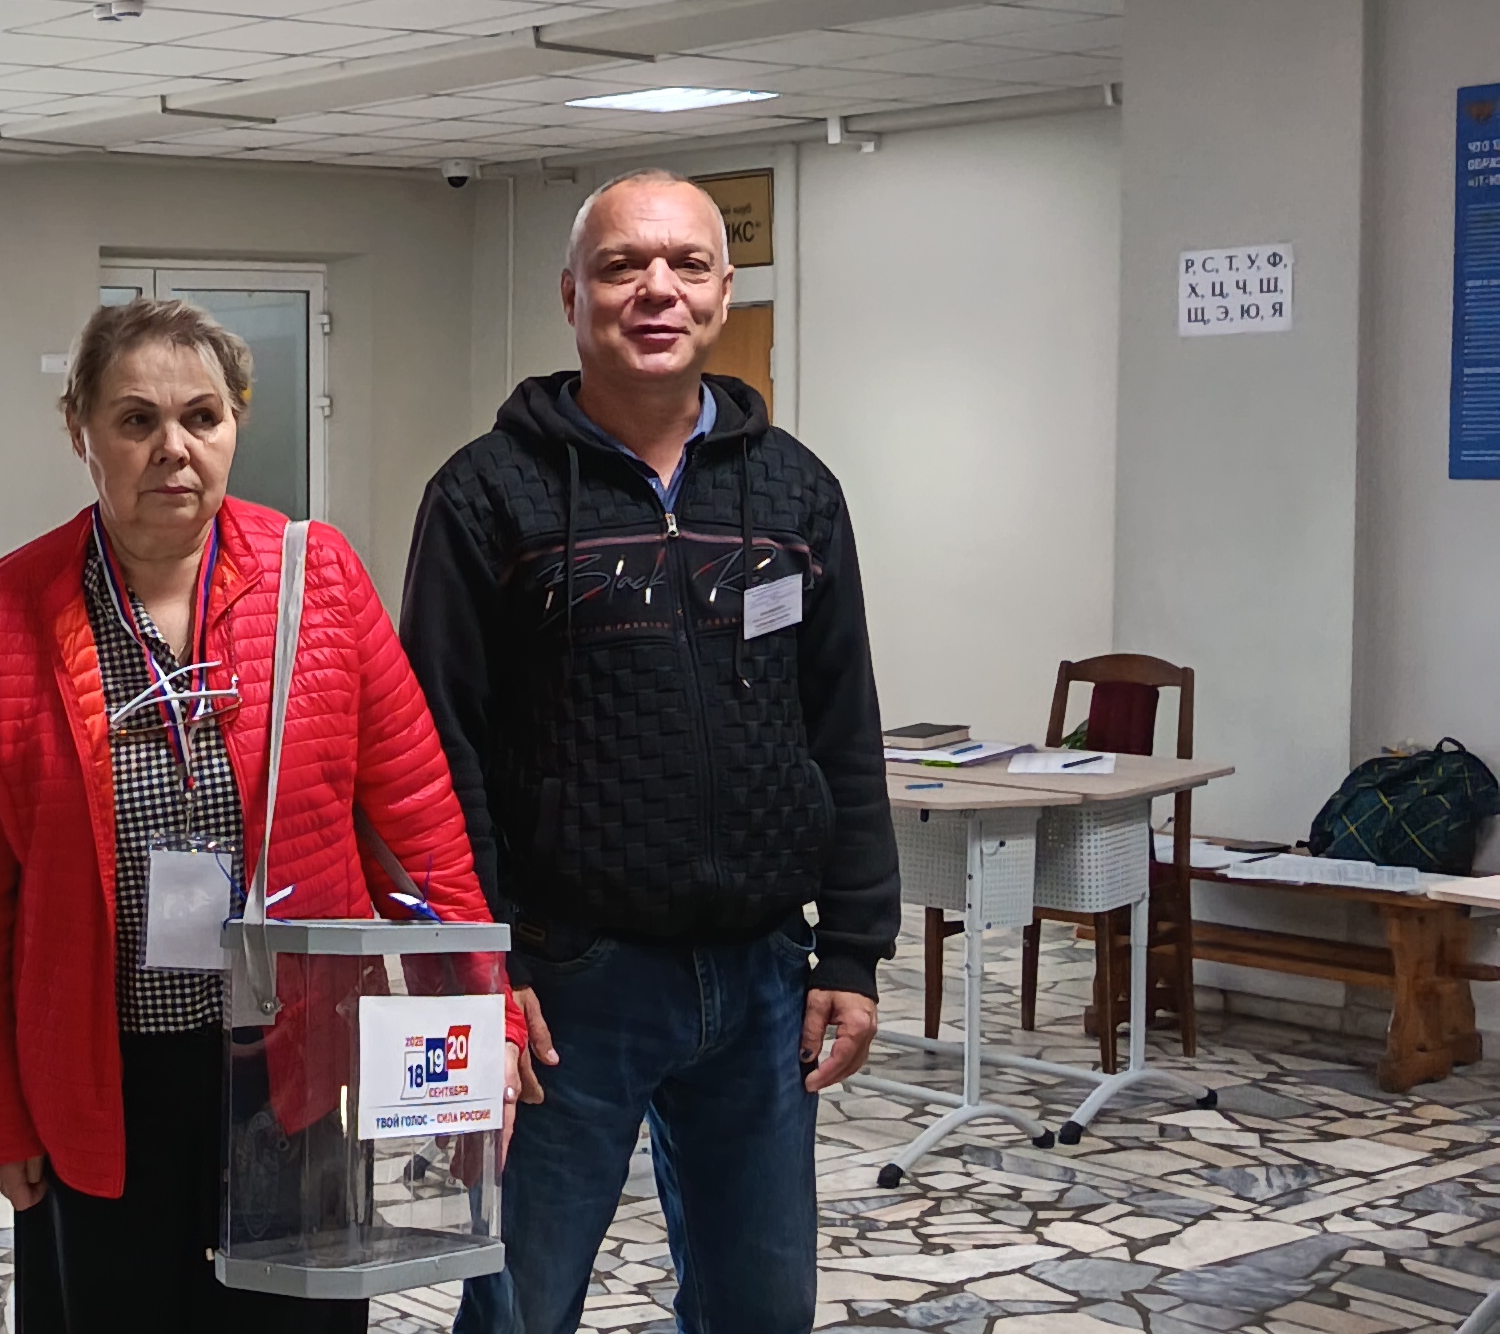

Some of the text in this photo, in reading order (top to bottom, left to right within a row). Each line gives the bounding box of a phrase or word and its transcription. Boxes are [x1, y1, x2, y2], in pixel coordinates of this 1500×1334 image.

[1267, 251, 1287, 269] Ф,
[1240, 303, 1264, 321] Ю,
[1270, 301, 1283, 318] Я
[447, 1034, 467, 1060] 20
[427, 1048, 444, 1074] 19
[407, 1064, 424, 1088] 18
[376, 1113, 399, 1129] ТВОЙ
[401, 1114, 428, 1128] ГОЛОС
[436, 1112, 458, 1124] СИЛА
